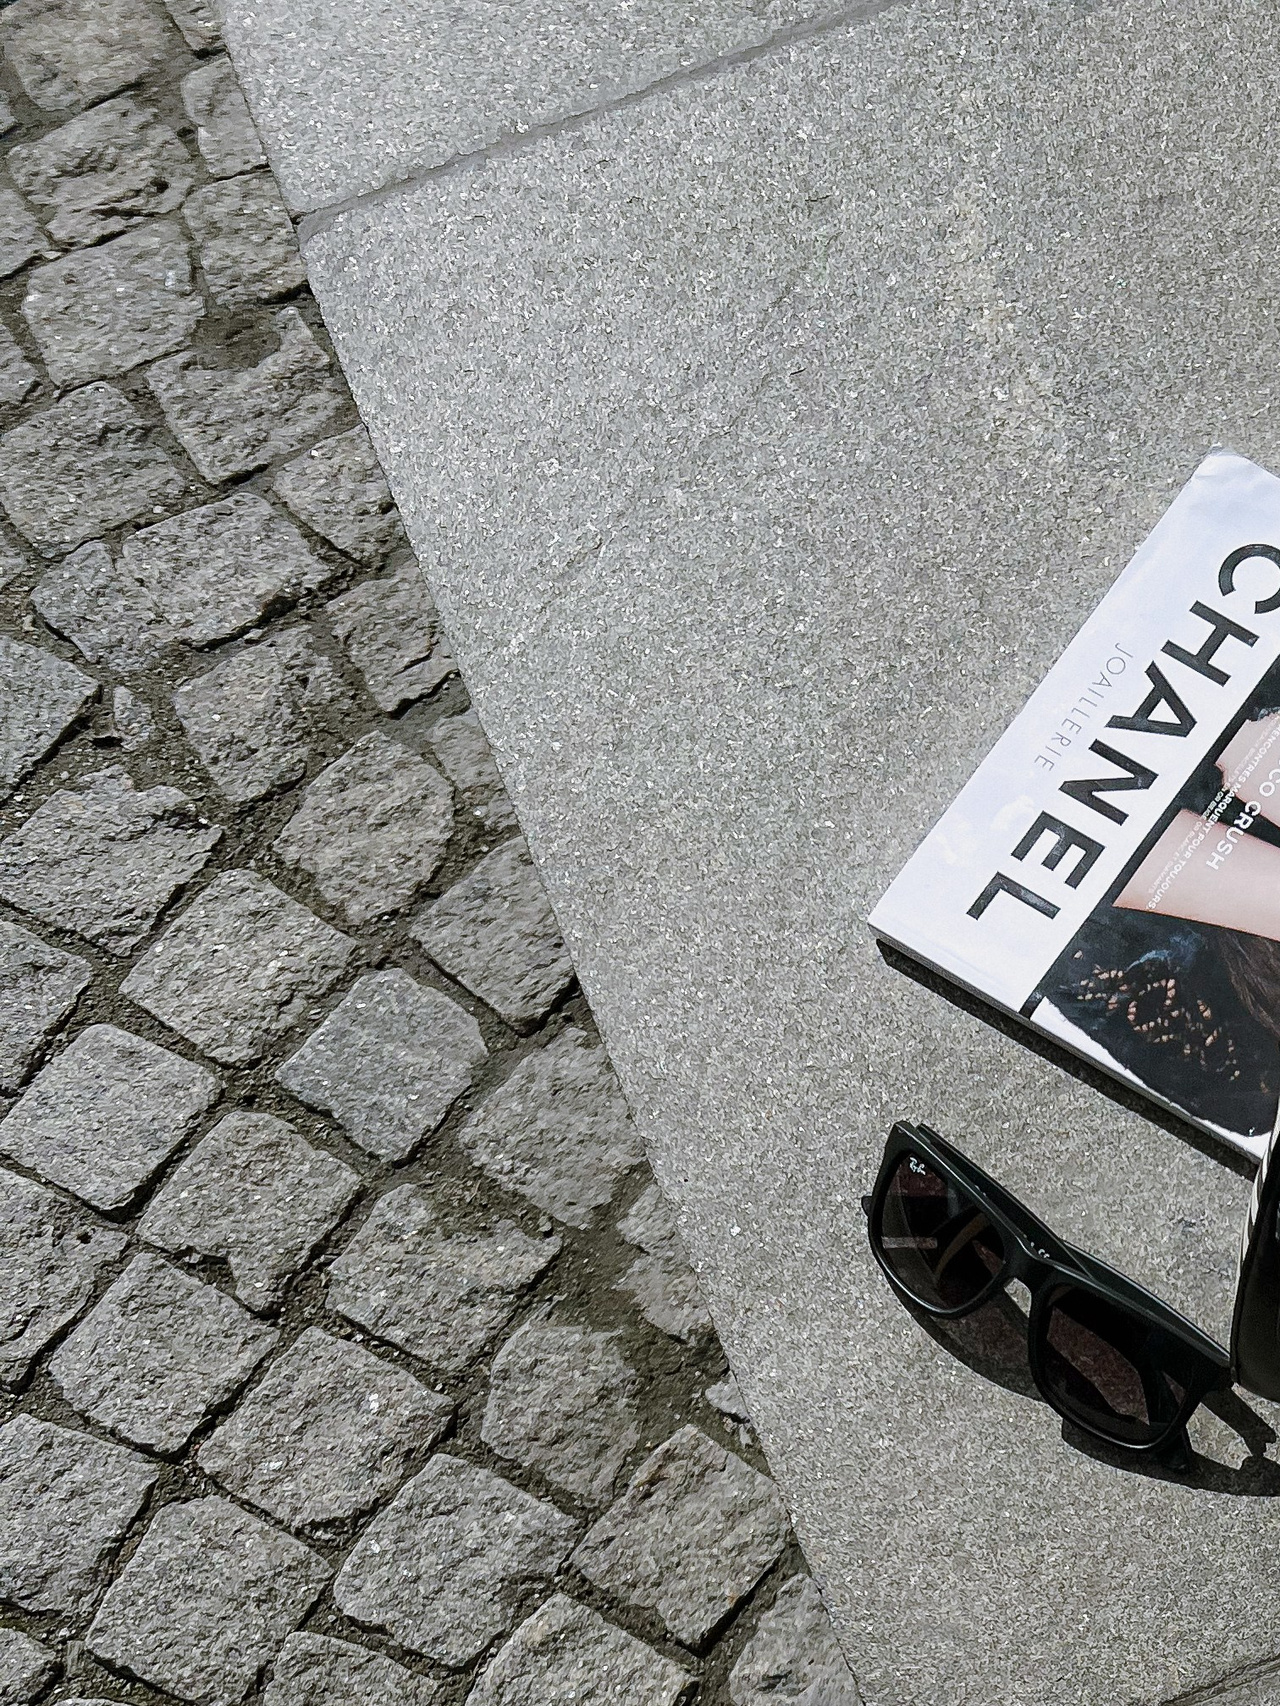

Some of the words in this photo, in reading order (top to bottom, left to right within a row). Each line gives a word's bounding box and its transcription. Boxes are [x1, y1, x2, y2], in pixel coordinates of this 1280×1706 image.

[1032, 641, 1136, 774] JOAILLERIE
[1200, 781, 1243, 834] MARQUENT
[1203, 799, 1263, 871] CRUSH
[1182, 831, 1206, 860] POUR
